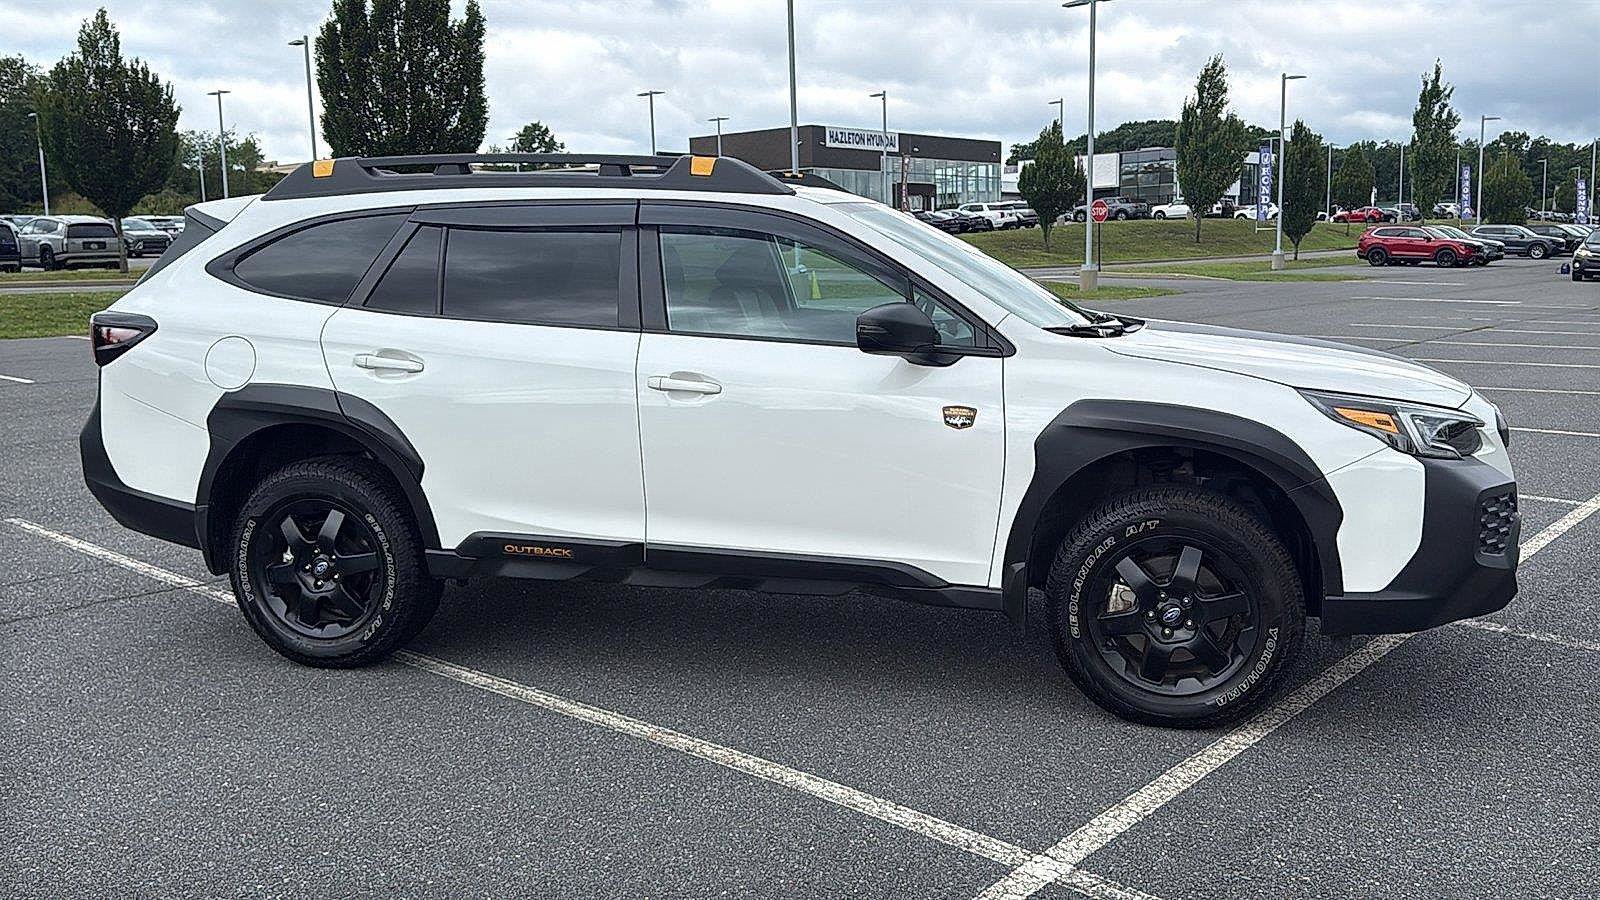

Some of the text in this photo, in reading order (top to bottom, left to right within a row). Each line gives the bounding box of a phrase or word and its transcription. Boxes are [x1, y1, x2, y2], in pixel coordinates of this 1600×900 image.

[829, 130, 865, 146] HAZLETON
[1261, 167, 1270, 213] HONDA
[1092, 207, 1107, 216] STOP
[504, 544, 573, 557] OUTBACK
[1068, 519, 1160, 639] GEOLANDAR A/T
[1215, 626, 1279, 707] YOKOHAMA
